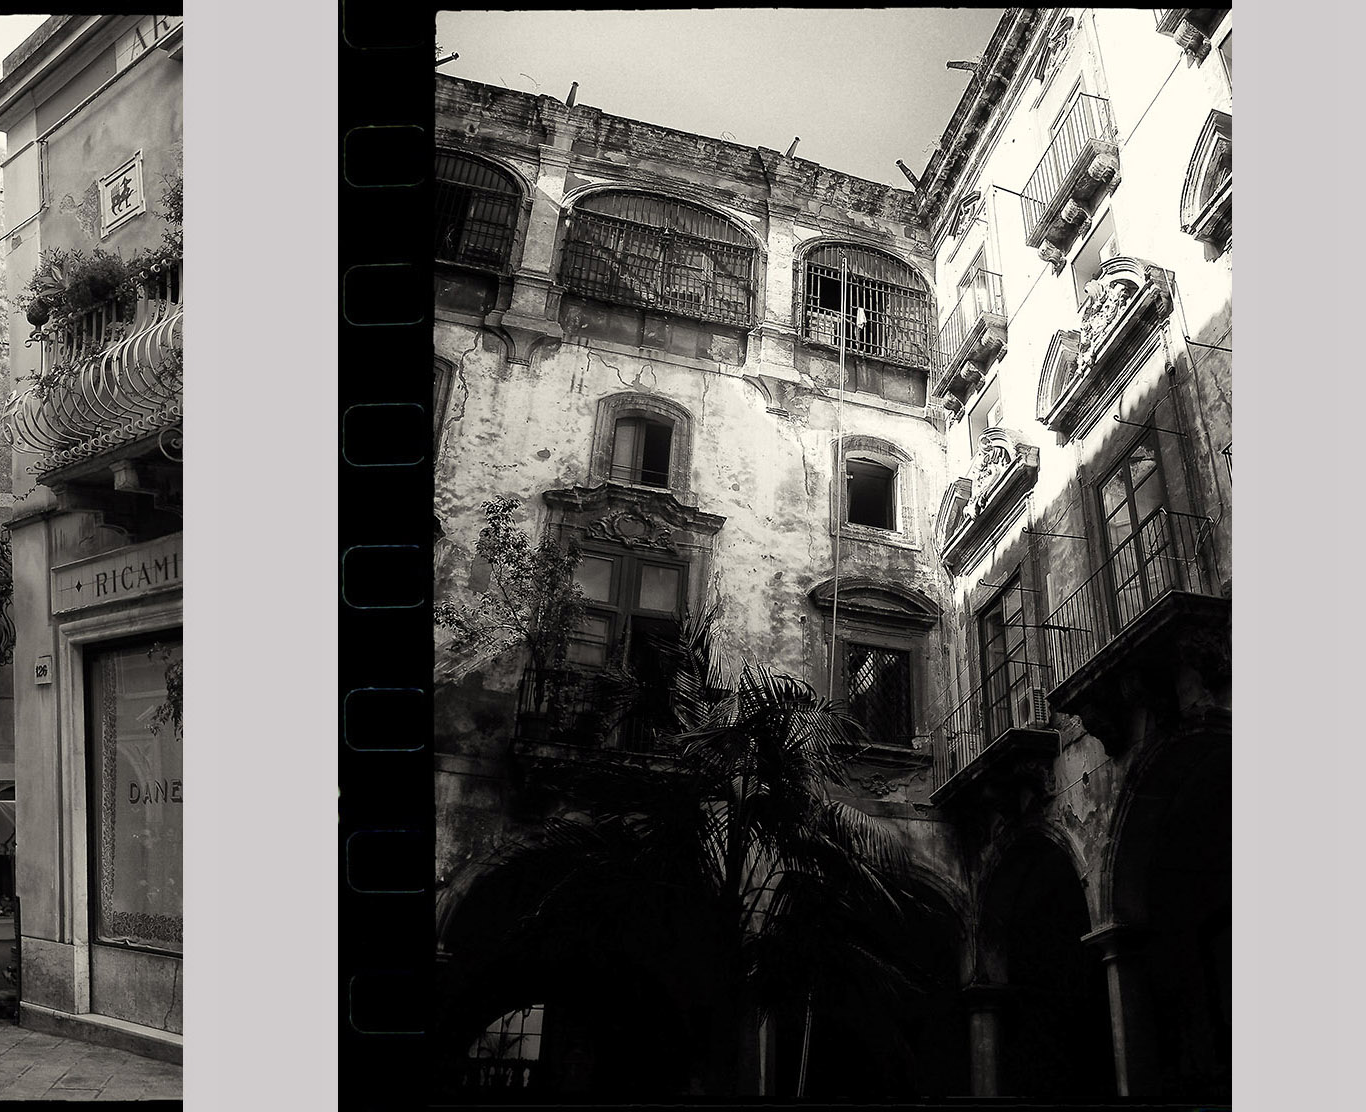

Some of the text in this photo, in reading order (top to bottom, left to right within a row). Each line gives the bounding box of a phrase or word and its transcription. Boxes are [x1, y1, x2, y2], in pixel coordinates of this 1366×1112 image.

[95, 552, 179, 598] RICAMI
[36, 664, 48, 678] 126
[129, 778, 183, 805] DANE
